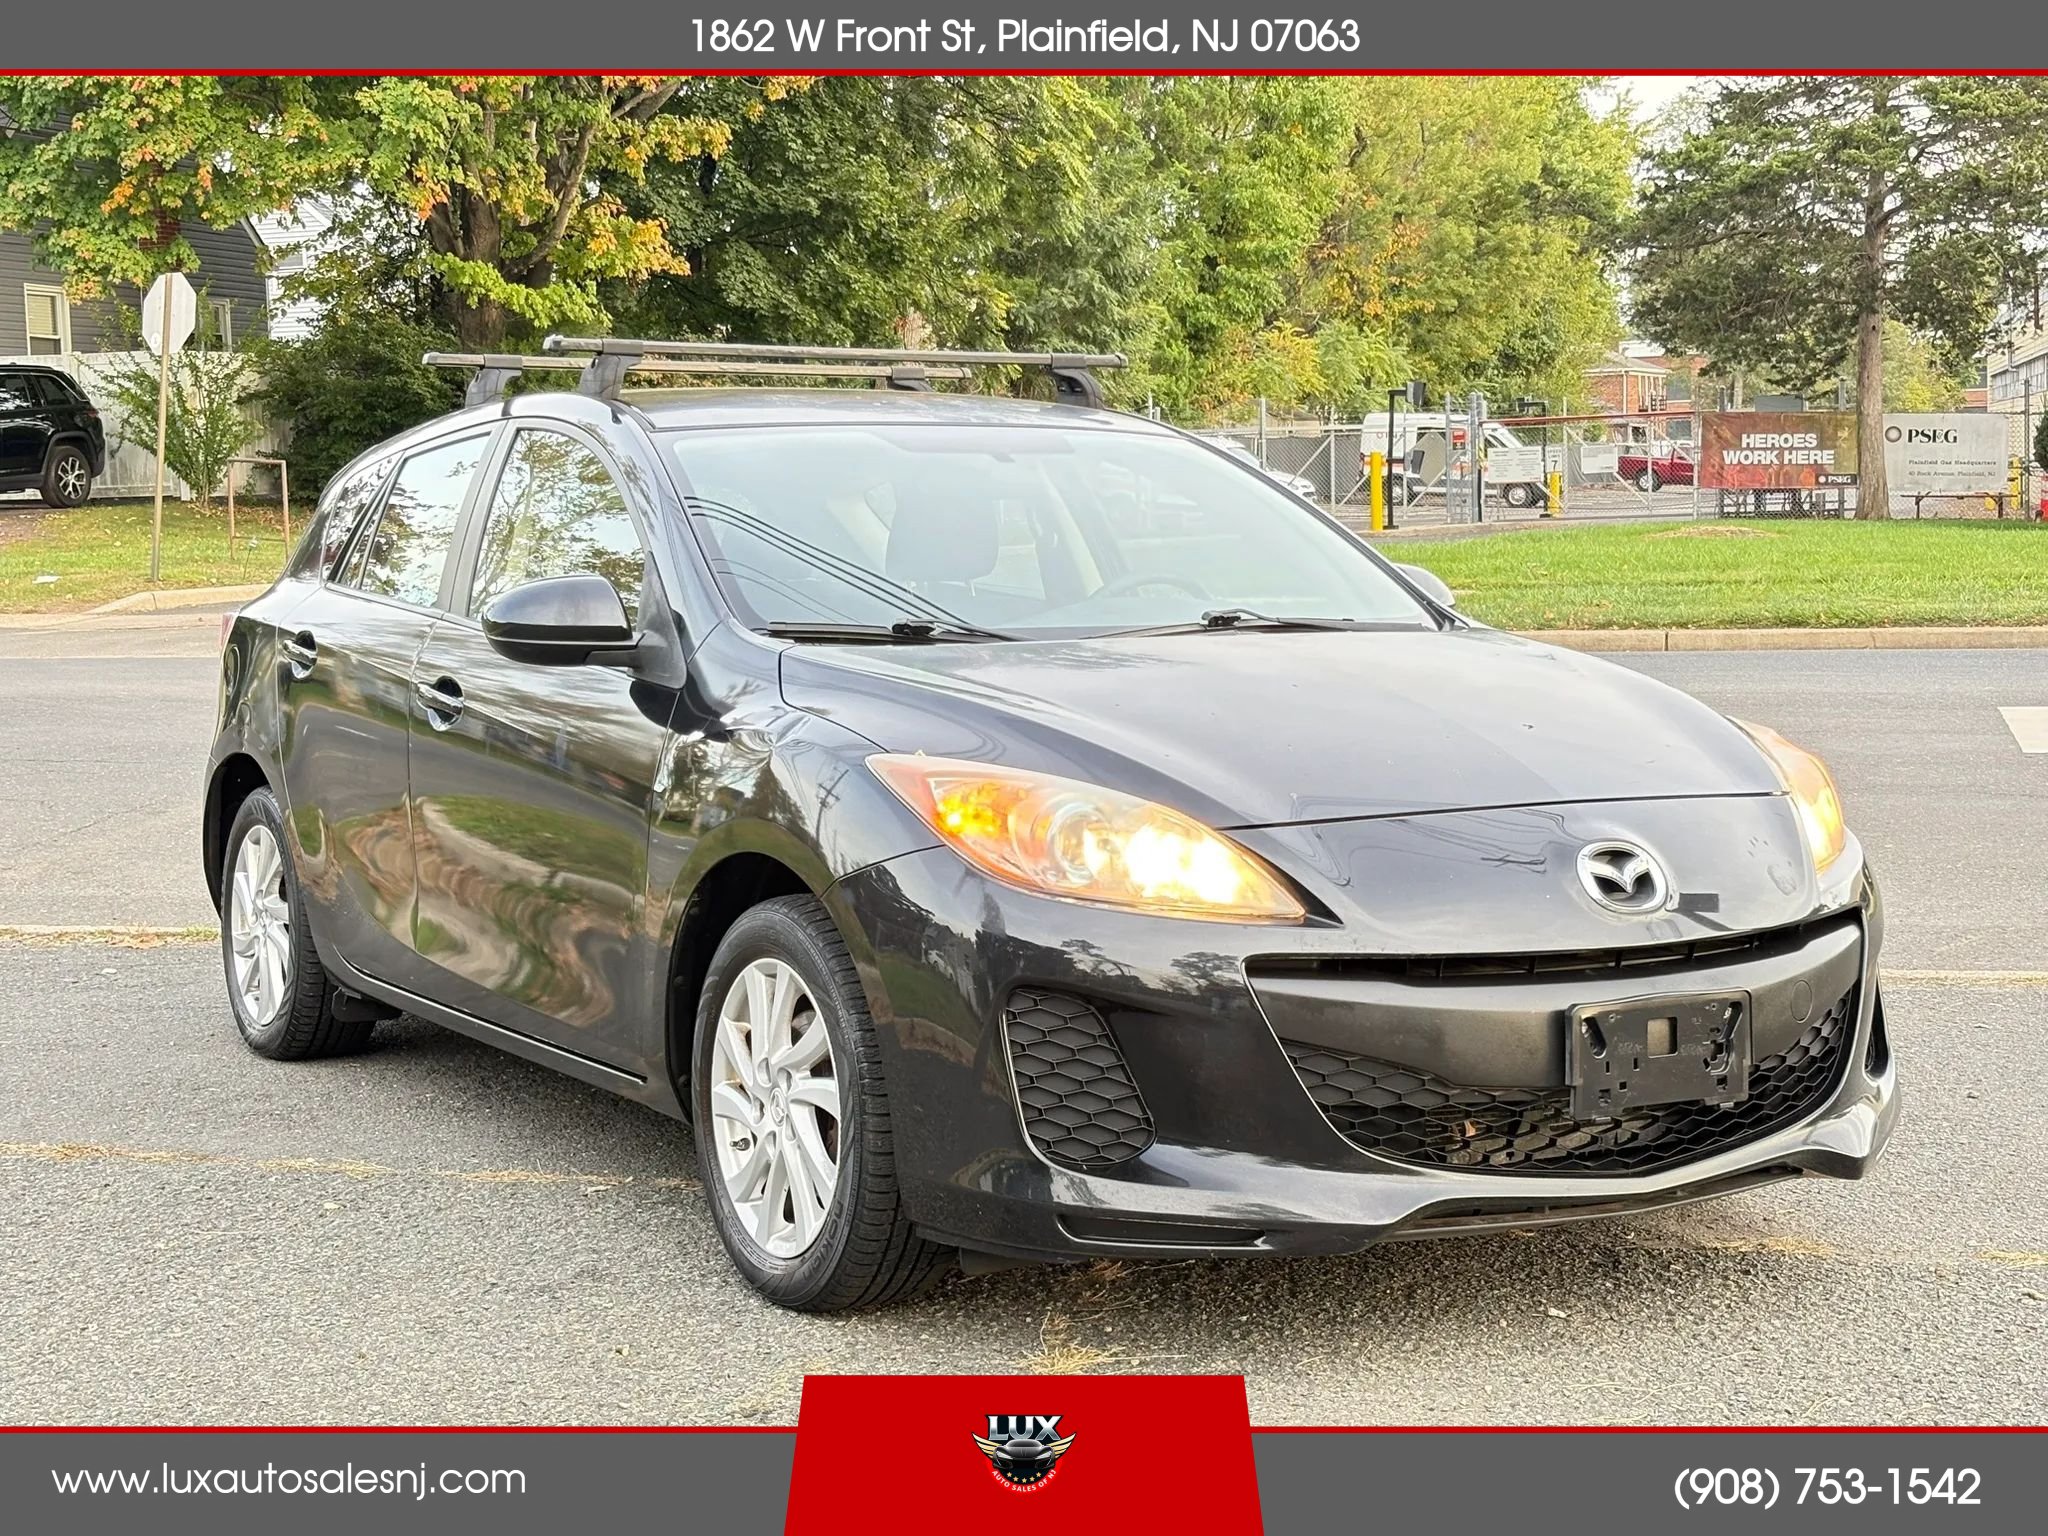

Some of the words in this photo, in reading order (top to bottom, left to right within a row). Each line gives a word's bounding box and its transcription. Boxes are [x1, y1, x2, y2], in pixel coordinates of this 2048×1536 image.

[1741, 433, 1817, 448] HEROES
[1722, 450, 1780, 465] WORK
[1783, 450, 1835, 465] HERE
